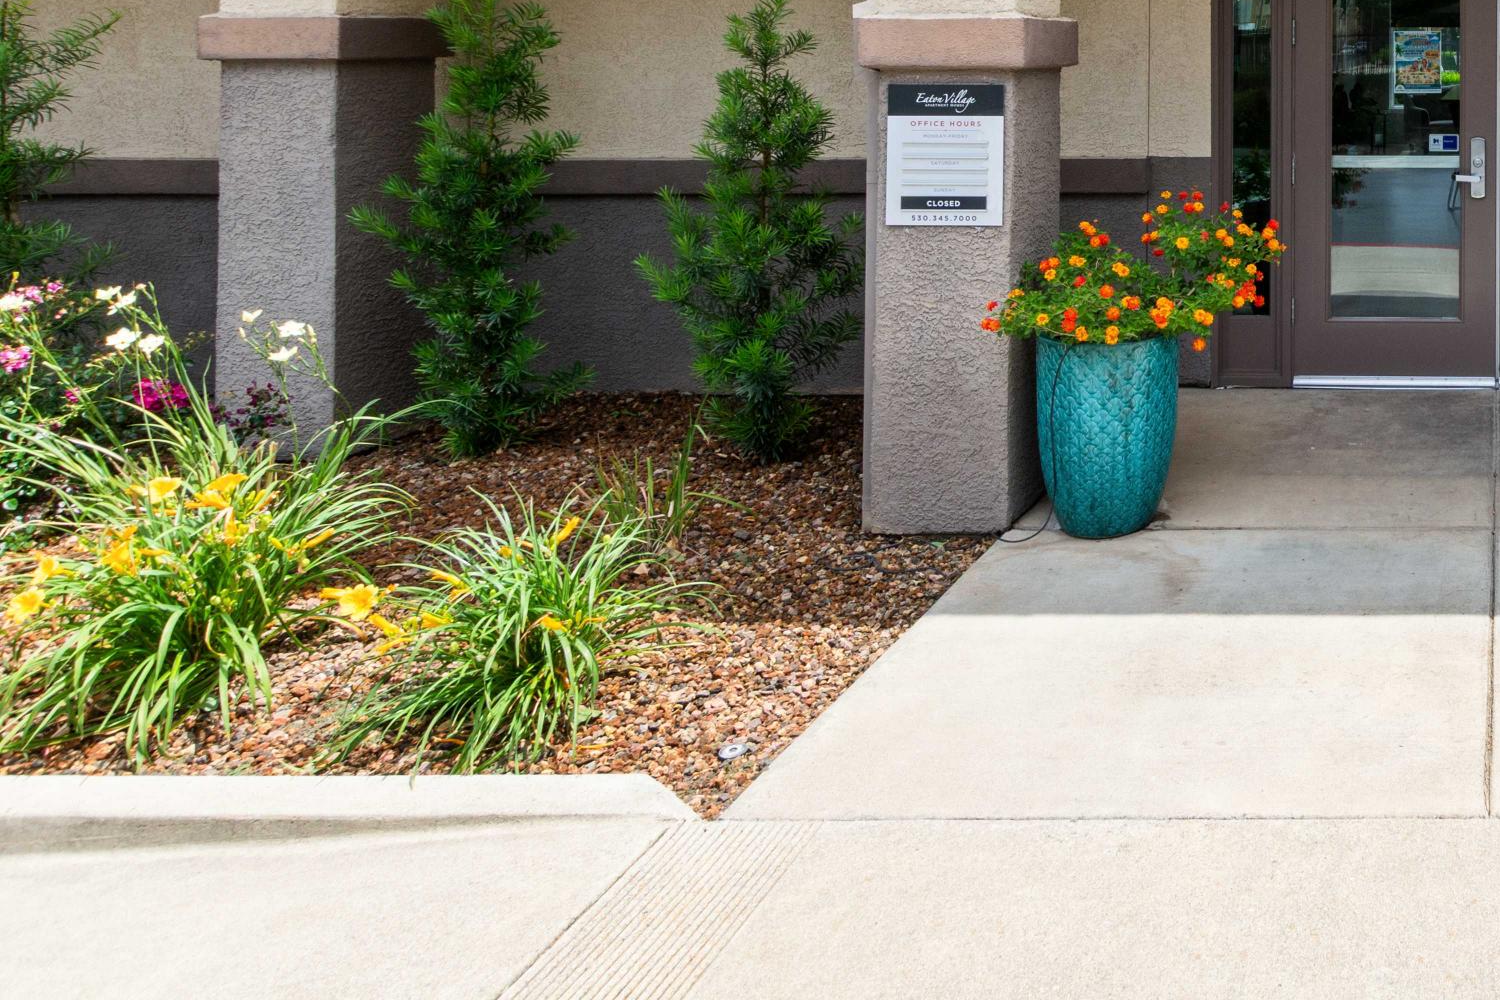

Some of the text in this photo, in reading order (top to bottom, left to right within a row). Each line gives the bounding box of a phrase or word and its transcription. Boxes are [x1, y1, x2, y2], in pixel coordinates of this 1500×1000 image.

[915, 89, 976, 113] Eaton Village
[949, 120, 982, 128] HOURS
[911, 214, 977, 222] 530.345.7000
